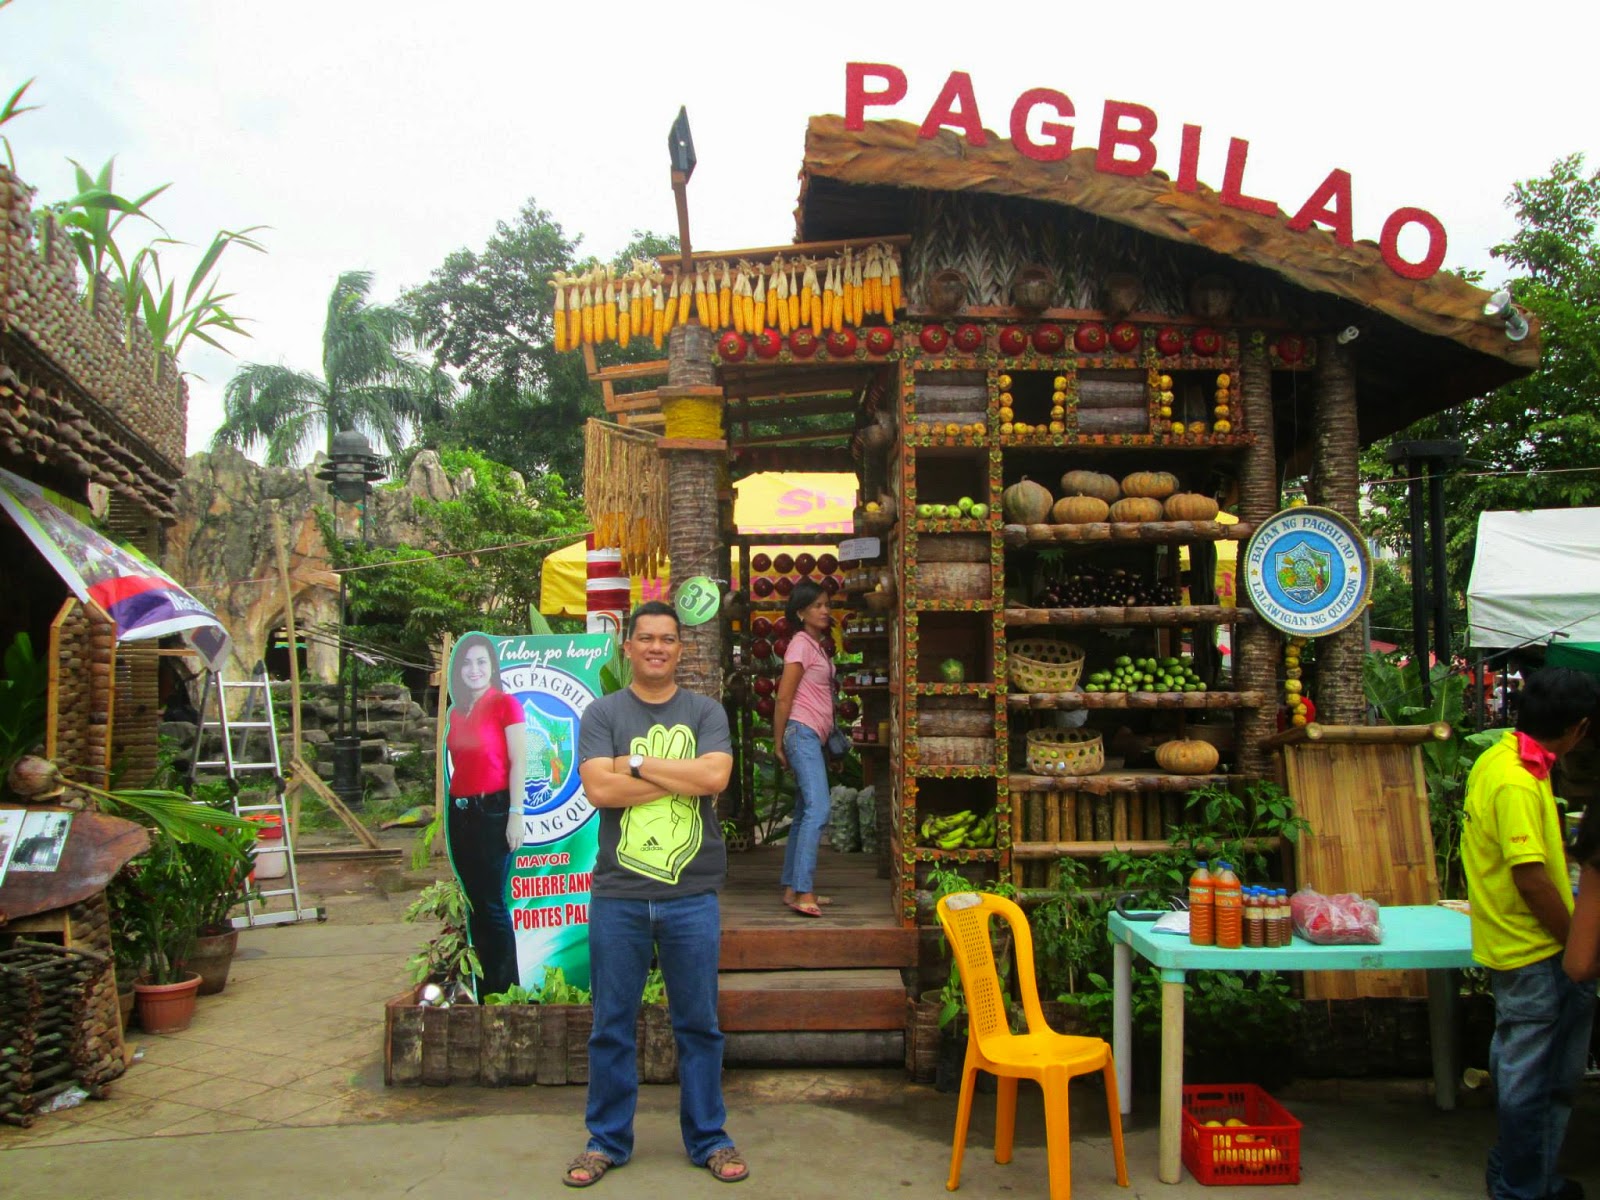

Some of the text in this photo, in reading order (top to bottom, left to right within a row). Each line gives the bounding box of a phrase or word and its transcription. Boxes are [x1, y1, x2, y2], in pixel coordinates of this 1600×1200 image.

[845, 62, 1448, 280] PAGBILAO
[1251, 517, 1355, 564] BAYAN NG PAGBILAO
[680, 583, 716, 618] 37
[1252, 582, 1307, 626] LALAWIGAN
[1310, 613, 1327, 625] NG
[1328, 579, 1358, 618] QUEZON
[497, 637, 611, 672] Tuloy po kayo!
[530, 672, 588, 713] PAGBIL
[540, 815, 563, 835] NG
[516, 852, 570, 868] MAYOR
[511, 874, 566, 899] SHIERRE
[512, 905, 563, 931] PORTES
